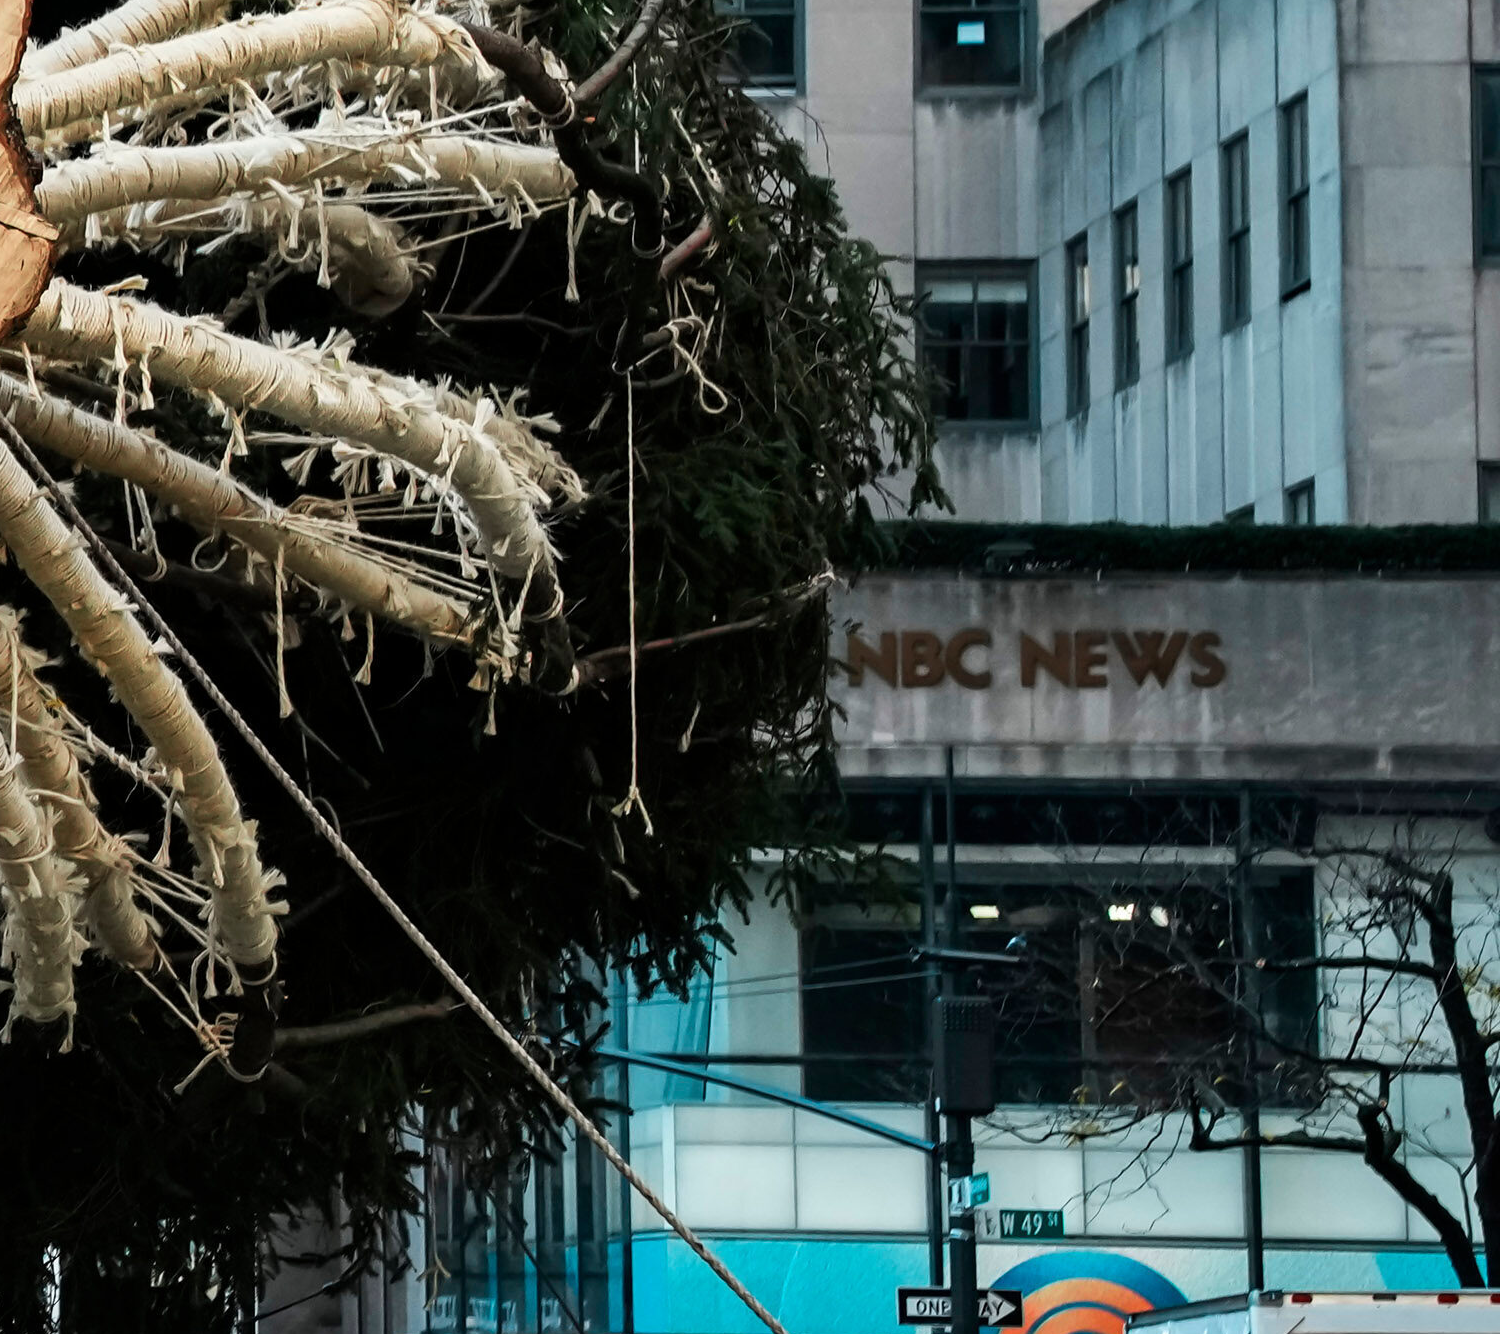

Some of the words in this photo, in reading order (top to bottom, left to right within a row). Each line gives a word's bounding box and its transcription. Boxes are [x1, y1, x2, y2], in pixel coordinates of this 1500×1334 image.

[847, 628, 993, 690] NBC
[1020, 629, 1228, 690] NEWS
[1002, 1212, 1015, 1236] W
[1021, 1212, 1043, 1236] 49
